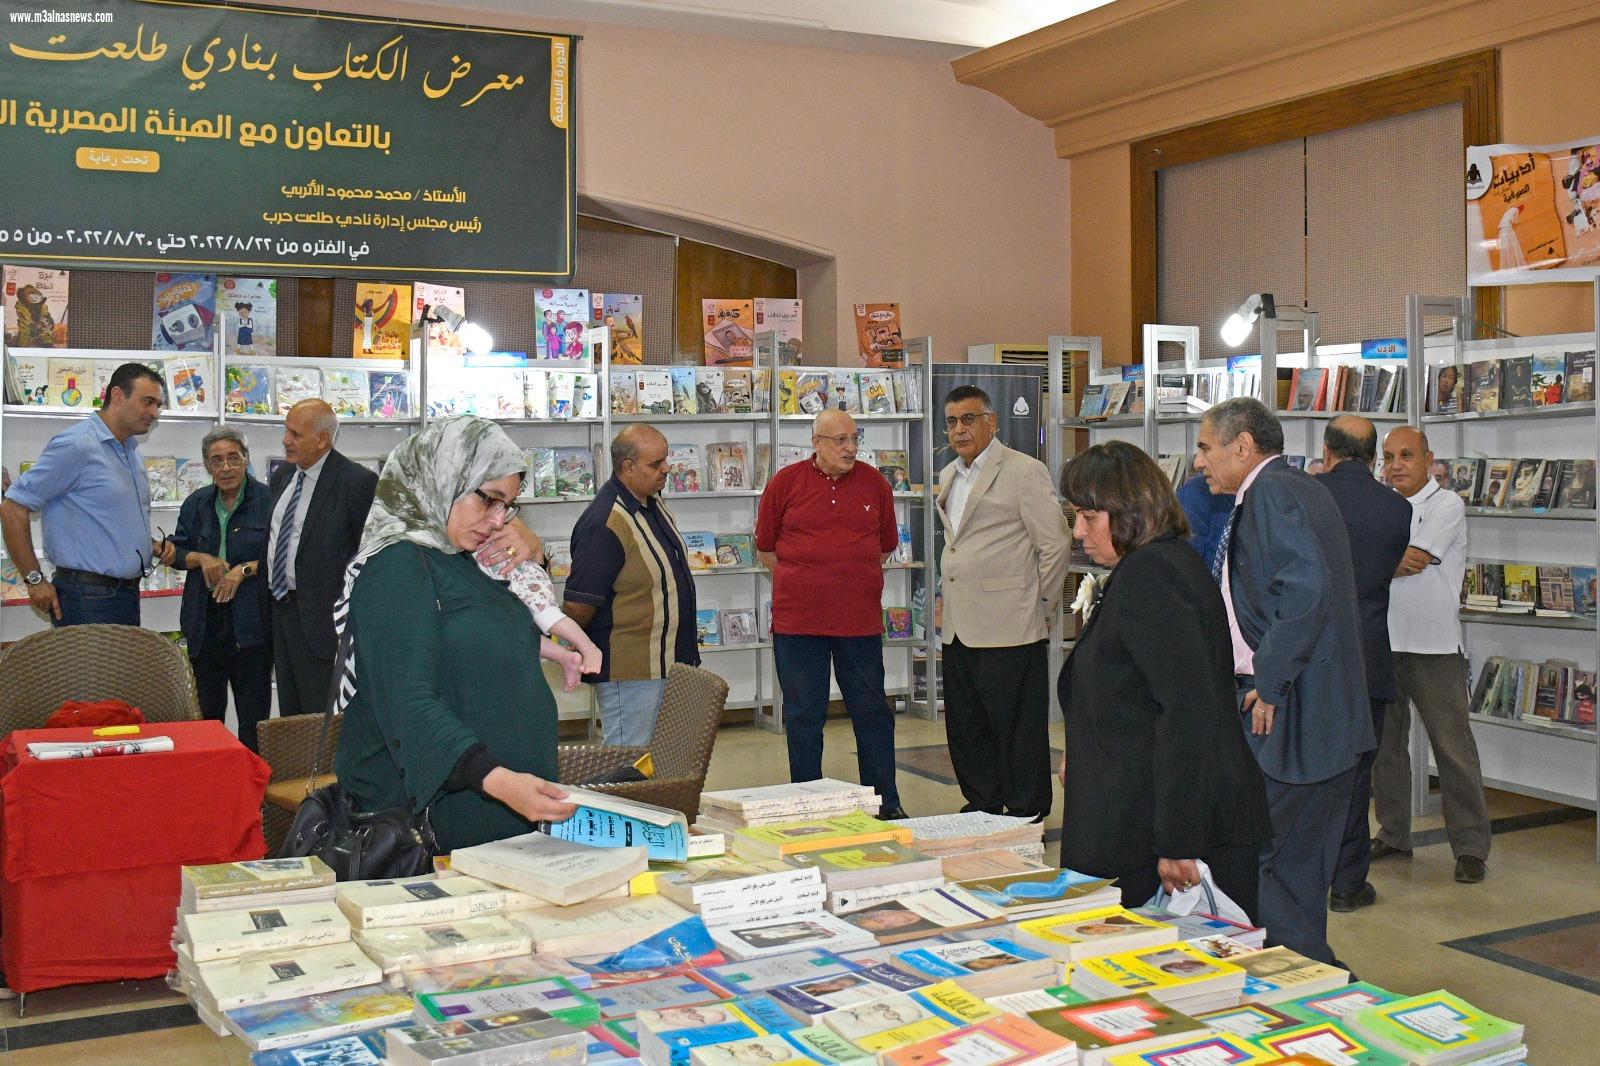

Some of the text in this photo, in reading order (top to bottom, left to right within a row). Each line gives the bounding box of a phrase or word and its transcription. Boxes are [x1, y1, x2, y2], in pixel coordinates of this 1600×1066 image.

[8, 23, 525, 108] معرض الكتاب بنادي طلعت
[552, 42, 566, 123] الدورة السابعة
[25, 100, 137, 135] المصرية
[144, 108, 232, 143] الهيئة
[239, 121, 278, 147] مع
[284, 118, 391, 154] بالتعاون
[88, 149, 148, 167] تحت رعاية
[1493, 152, 1536, 189] أدبيات
[326, 186, 374, 200] محمود
[374, 189, 413, 202] محمد
[422, 186, 467, 204] الأستاذ
[262, 210, 482, 234] رئيس مجلس إدارة نادي طلعت حرب
[13, 228, 23, 242] ٥
[26, 227, 52, 246] من
[276, 238, 298, 256] من
[349, 241, 370, 261] في
